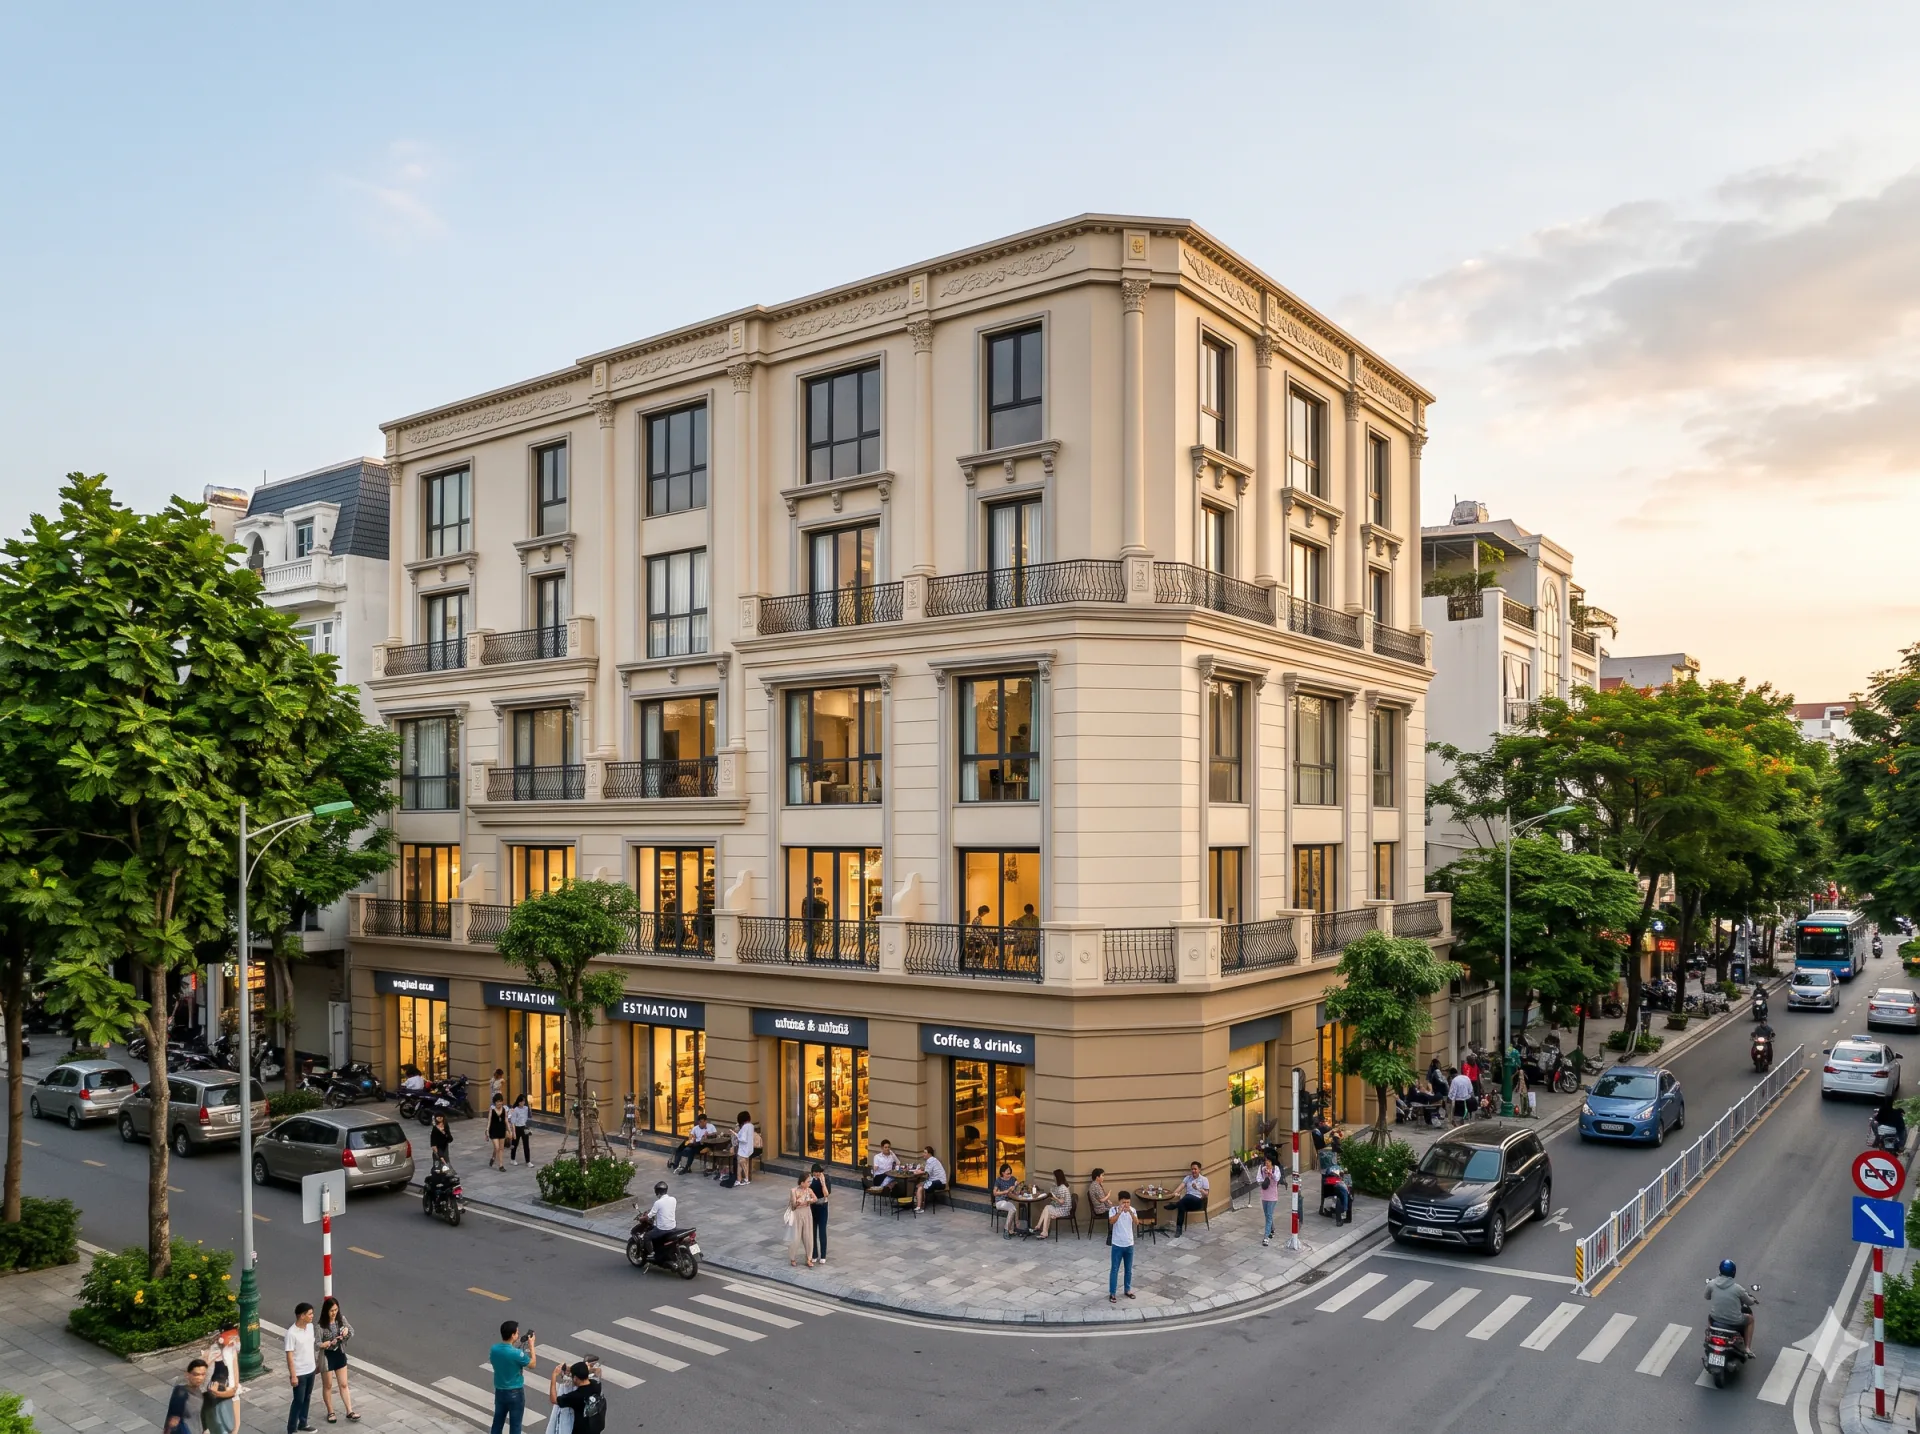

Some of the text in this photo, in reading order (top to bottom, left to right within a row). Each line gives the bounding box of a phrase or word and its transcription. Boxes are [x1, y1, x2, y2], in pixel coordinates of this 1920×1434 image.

[623, 1002, 688, 1019] ESTNATION
[933, 1033, 1023, 1054] Coffee & drinks
